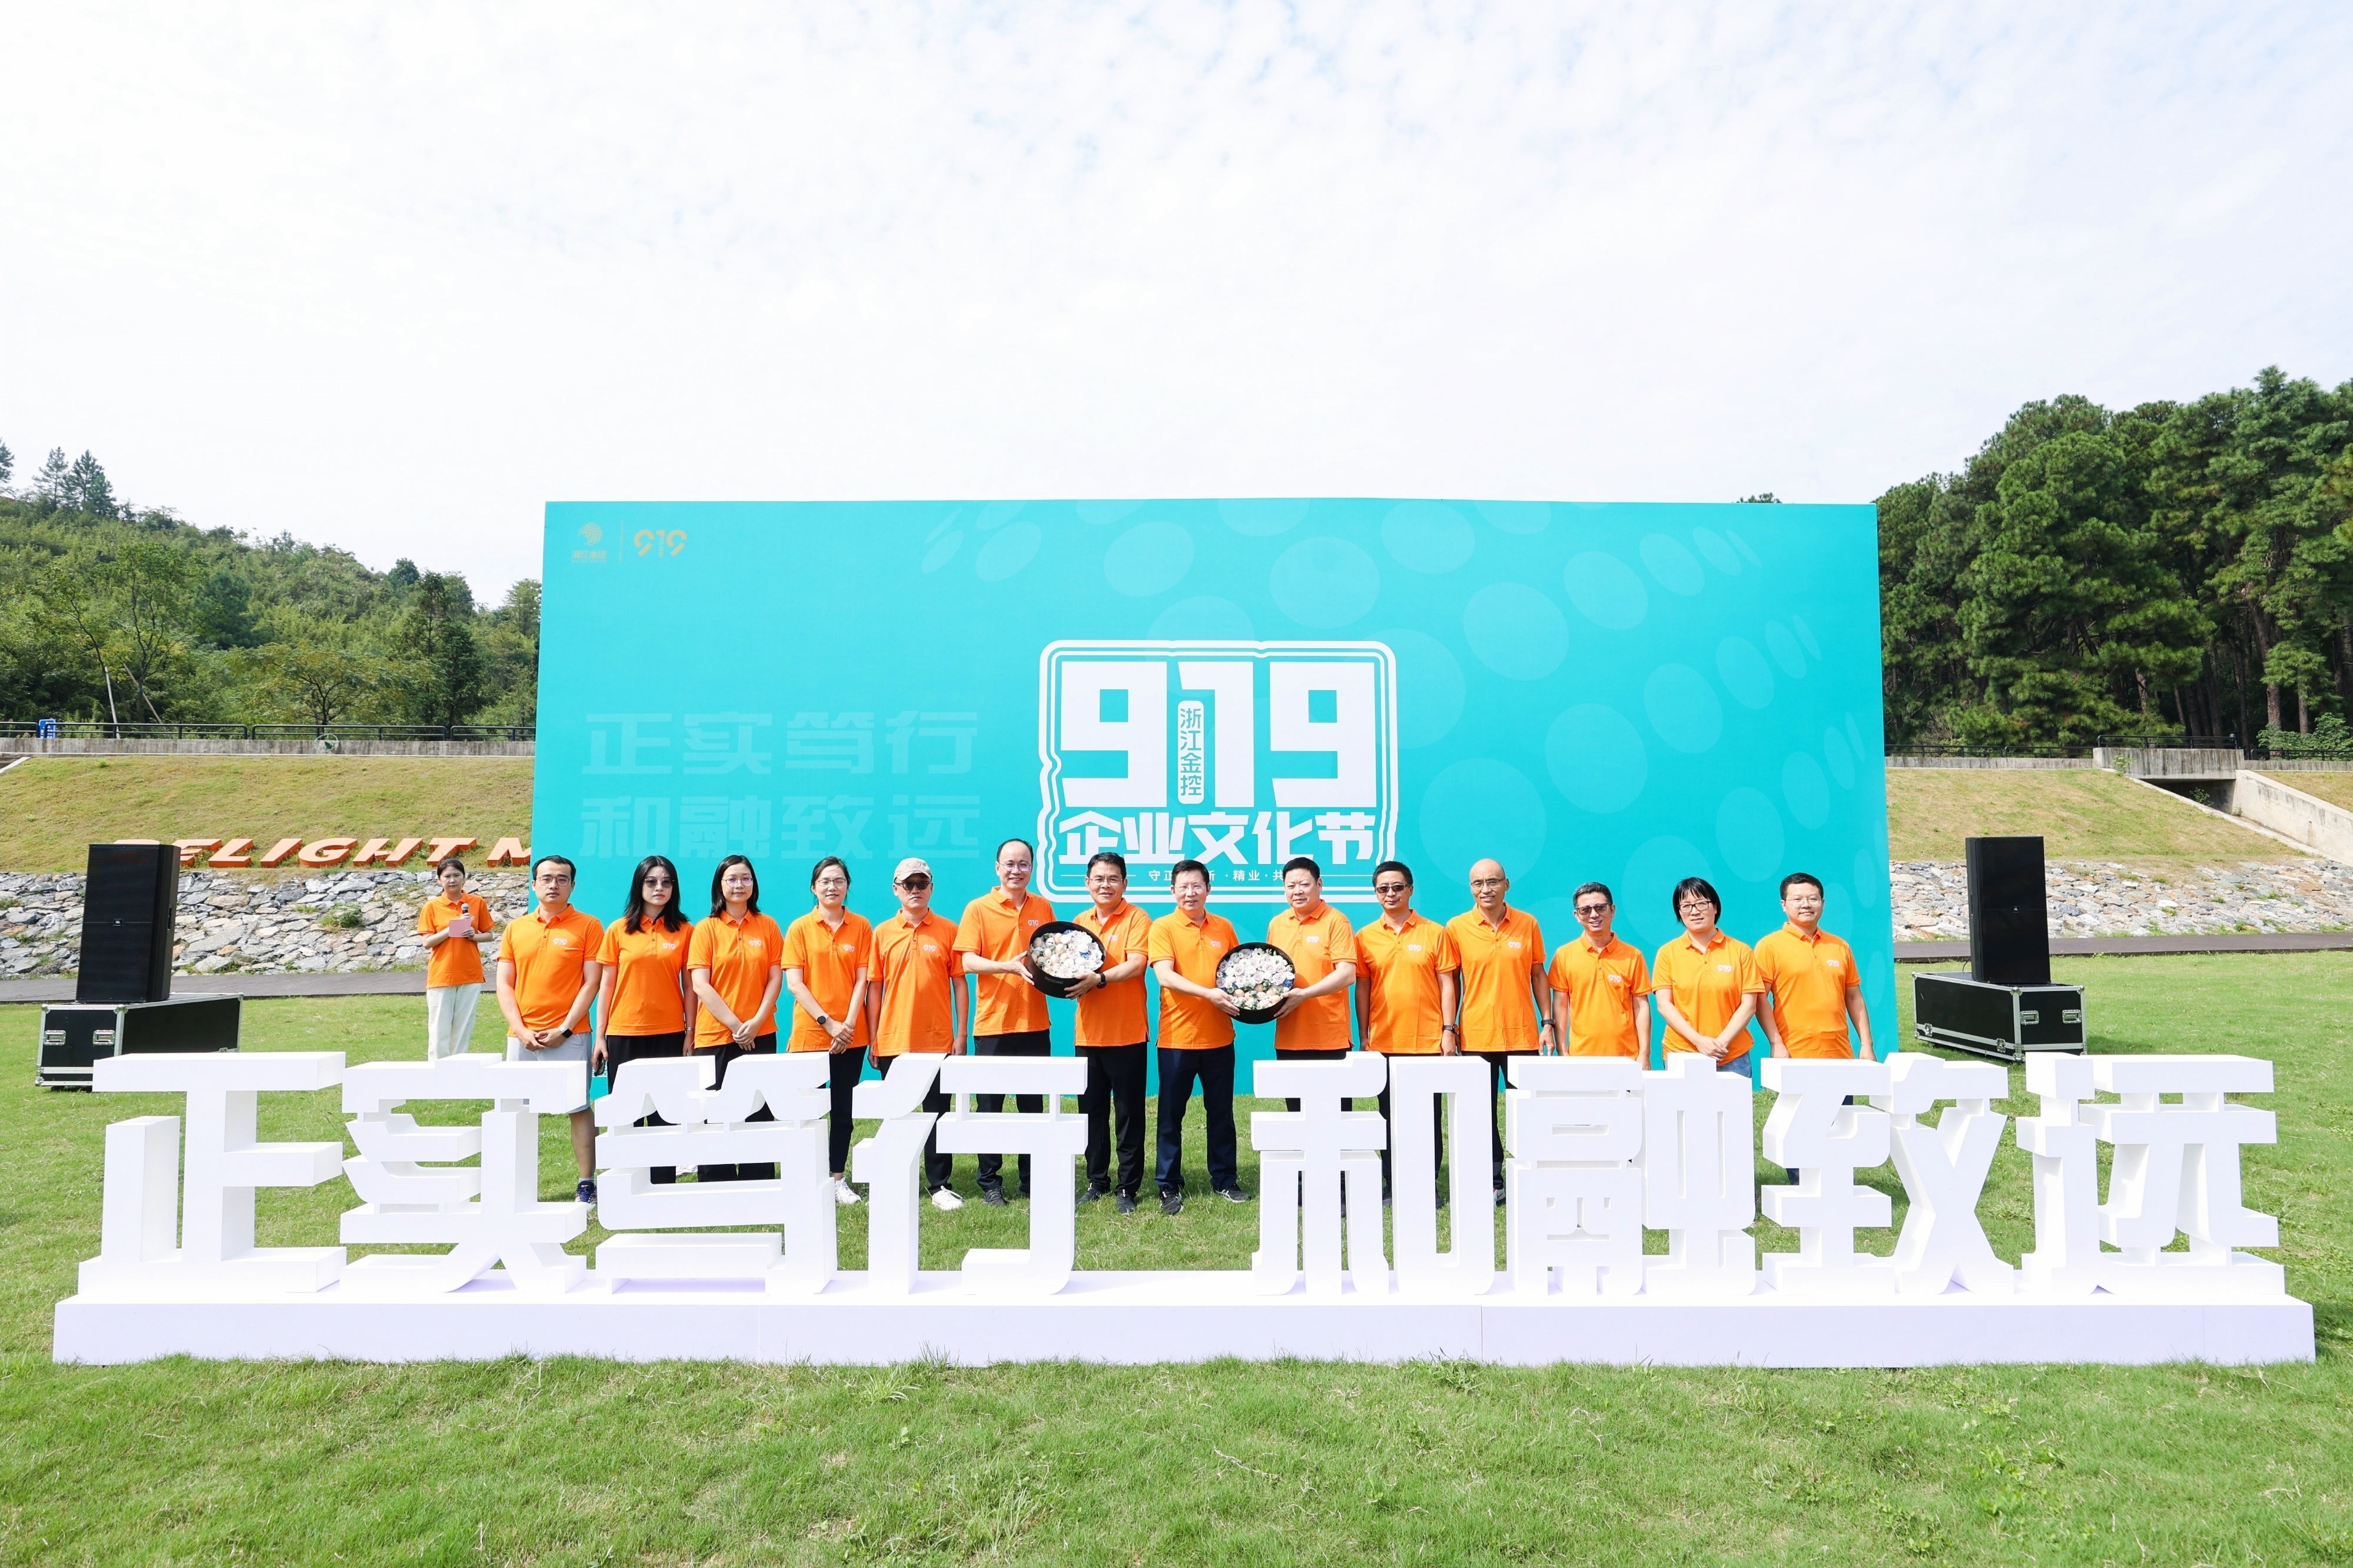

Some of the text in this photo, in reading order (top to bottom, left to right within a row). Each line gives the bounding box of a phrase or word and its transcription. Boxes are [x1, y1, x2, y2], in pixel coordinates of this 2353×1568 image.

[634, 529, 687, 556] 919
[581, 710, 978, 775] 正实笃行
[1061, 661, 1377, 808] 919
[1180, 708, 1202, 796] 浙江金控
[114, 838, 477, 868] ELIGHT
[579, 794, 980, 859] 和融致远
[1059, 810, 1377, 865] 企业文化节
[78, 1050, 2285, 1296] 正实笃行 和融致远
